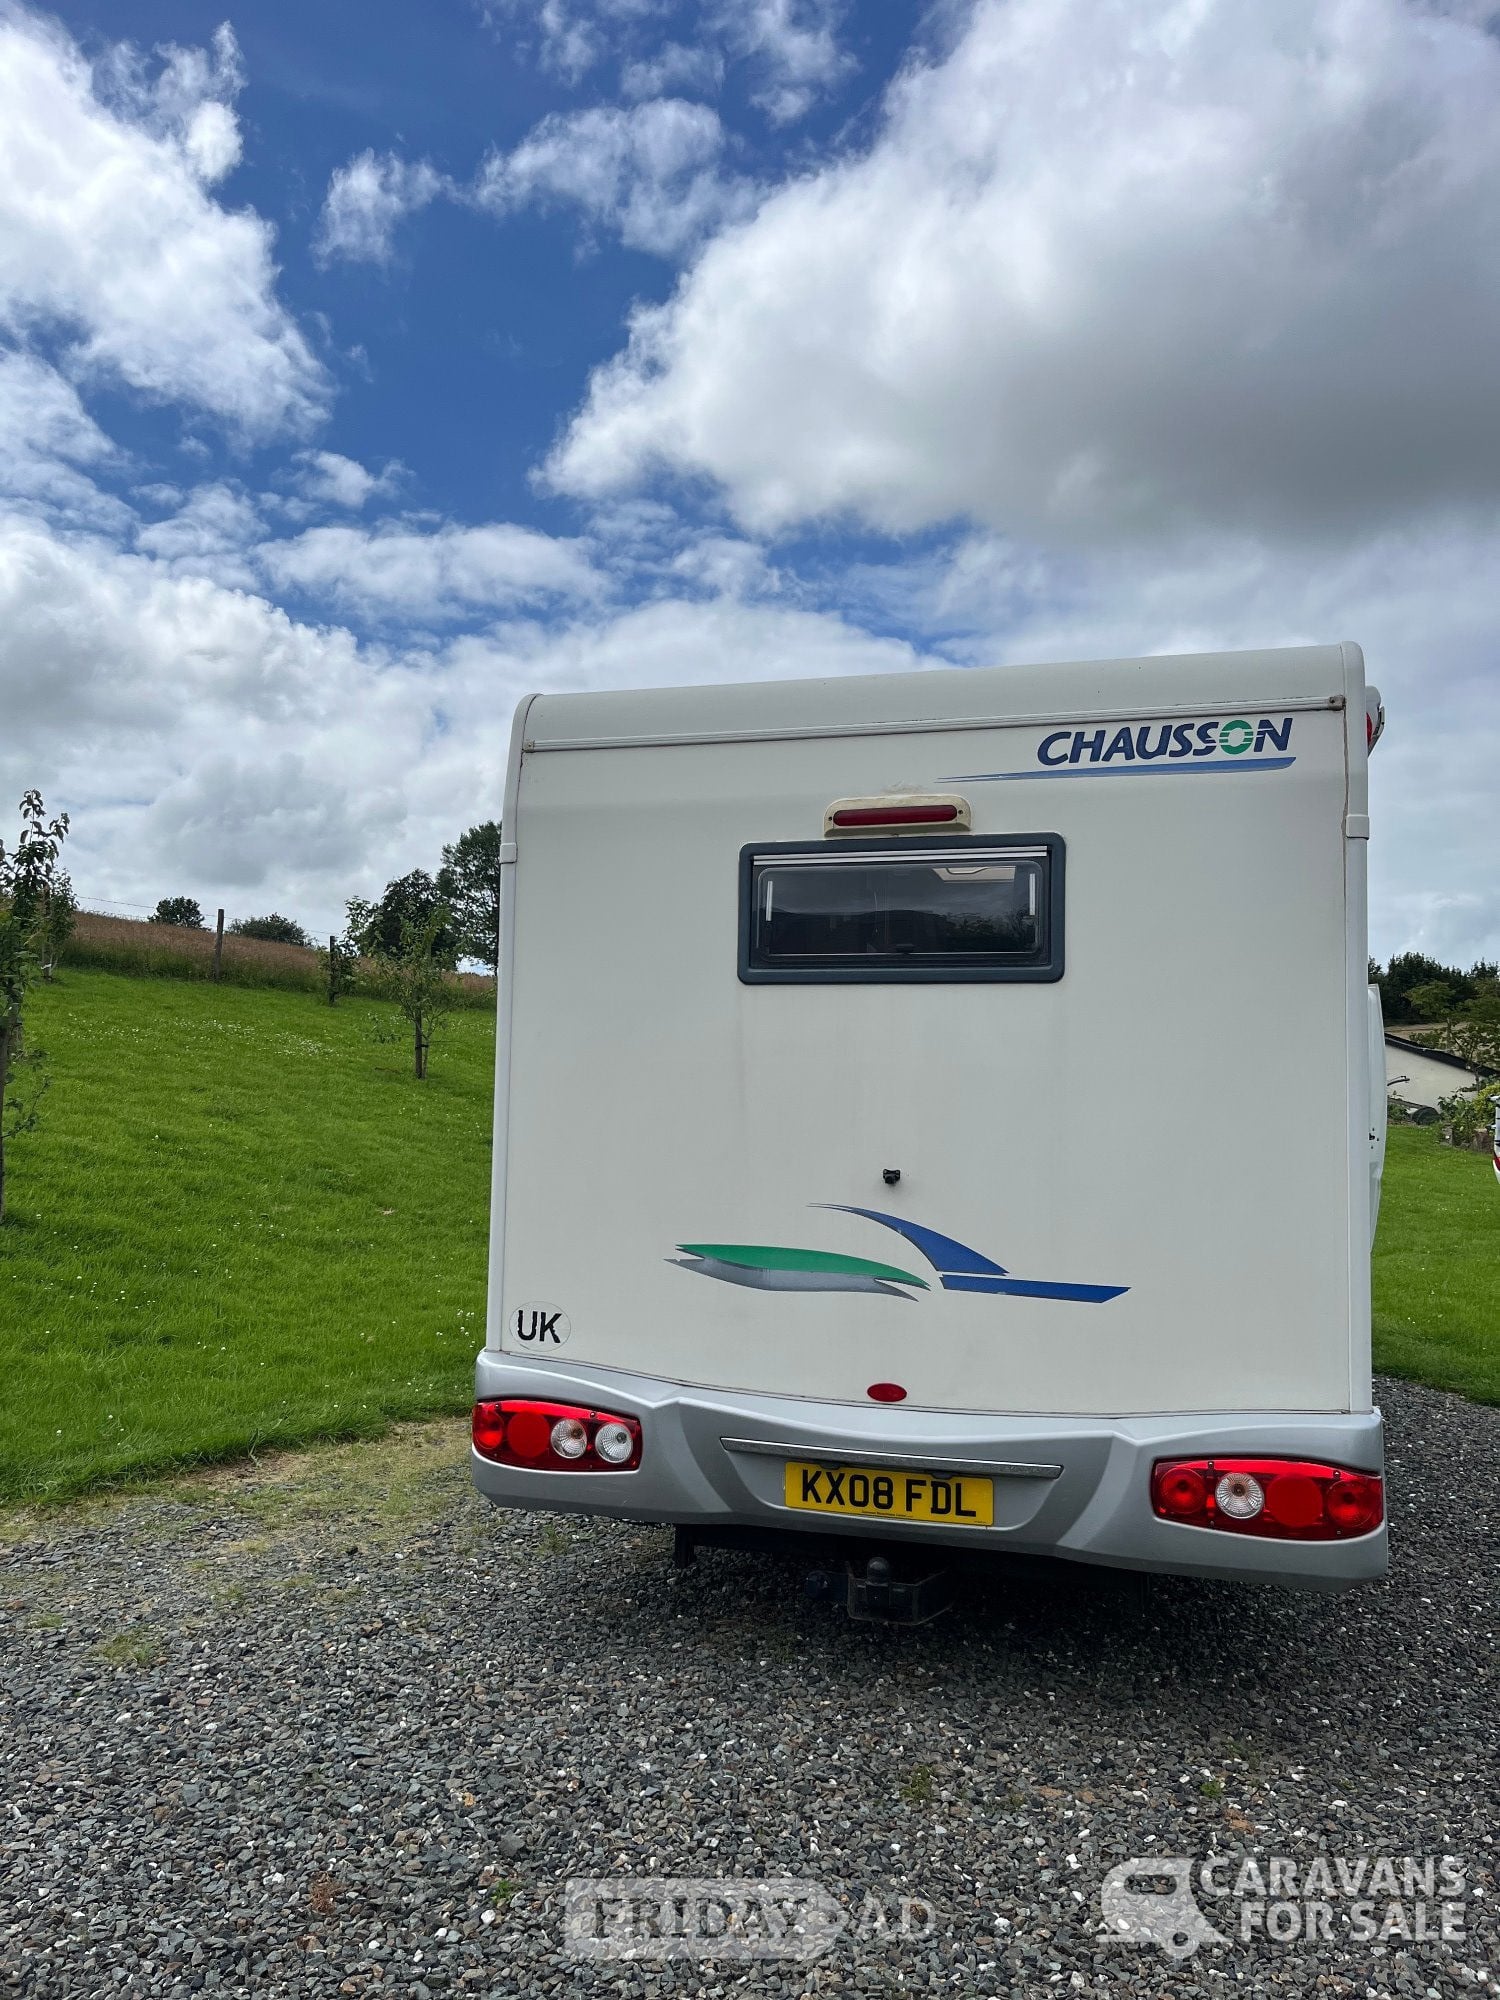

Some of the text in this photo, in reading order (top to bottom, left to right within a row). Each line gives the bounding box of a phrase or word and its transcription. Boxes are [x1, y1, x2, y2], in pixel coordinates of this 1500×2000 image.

[1036, 717, 1294, 767] CHAUSSON
[517, 1310, 562, 1344] UK
[801, 1468, 977, 1518] KX08 FDL
